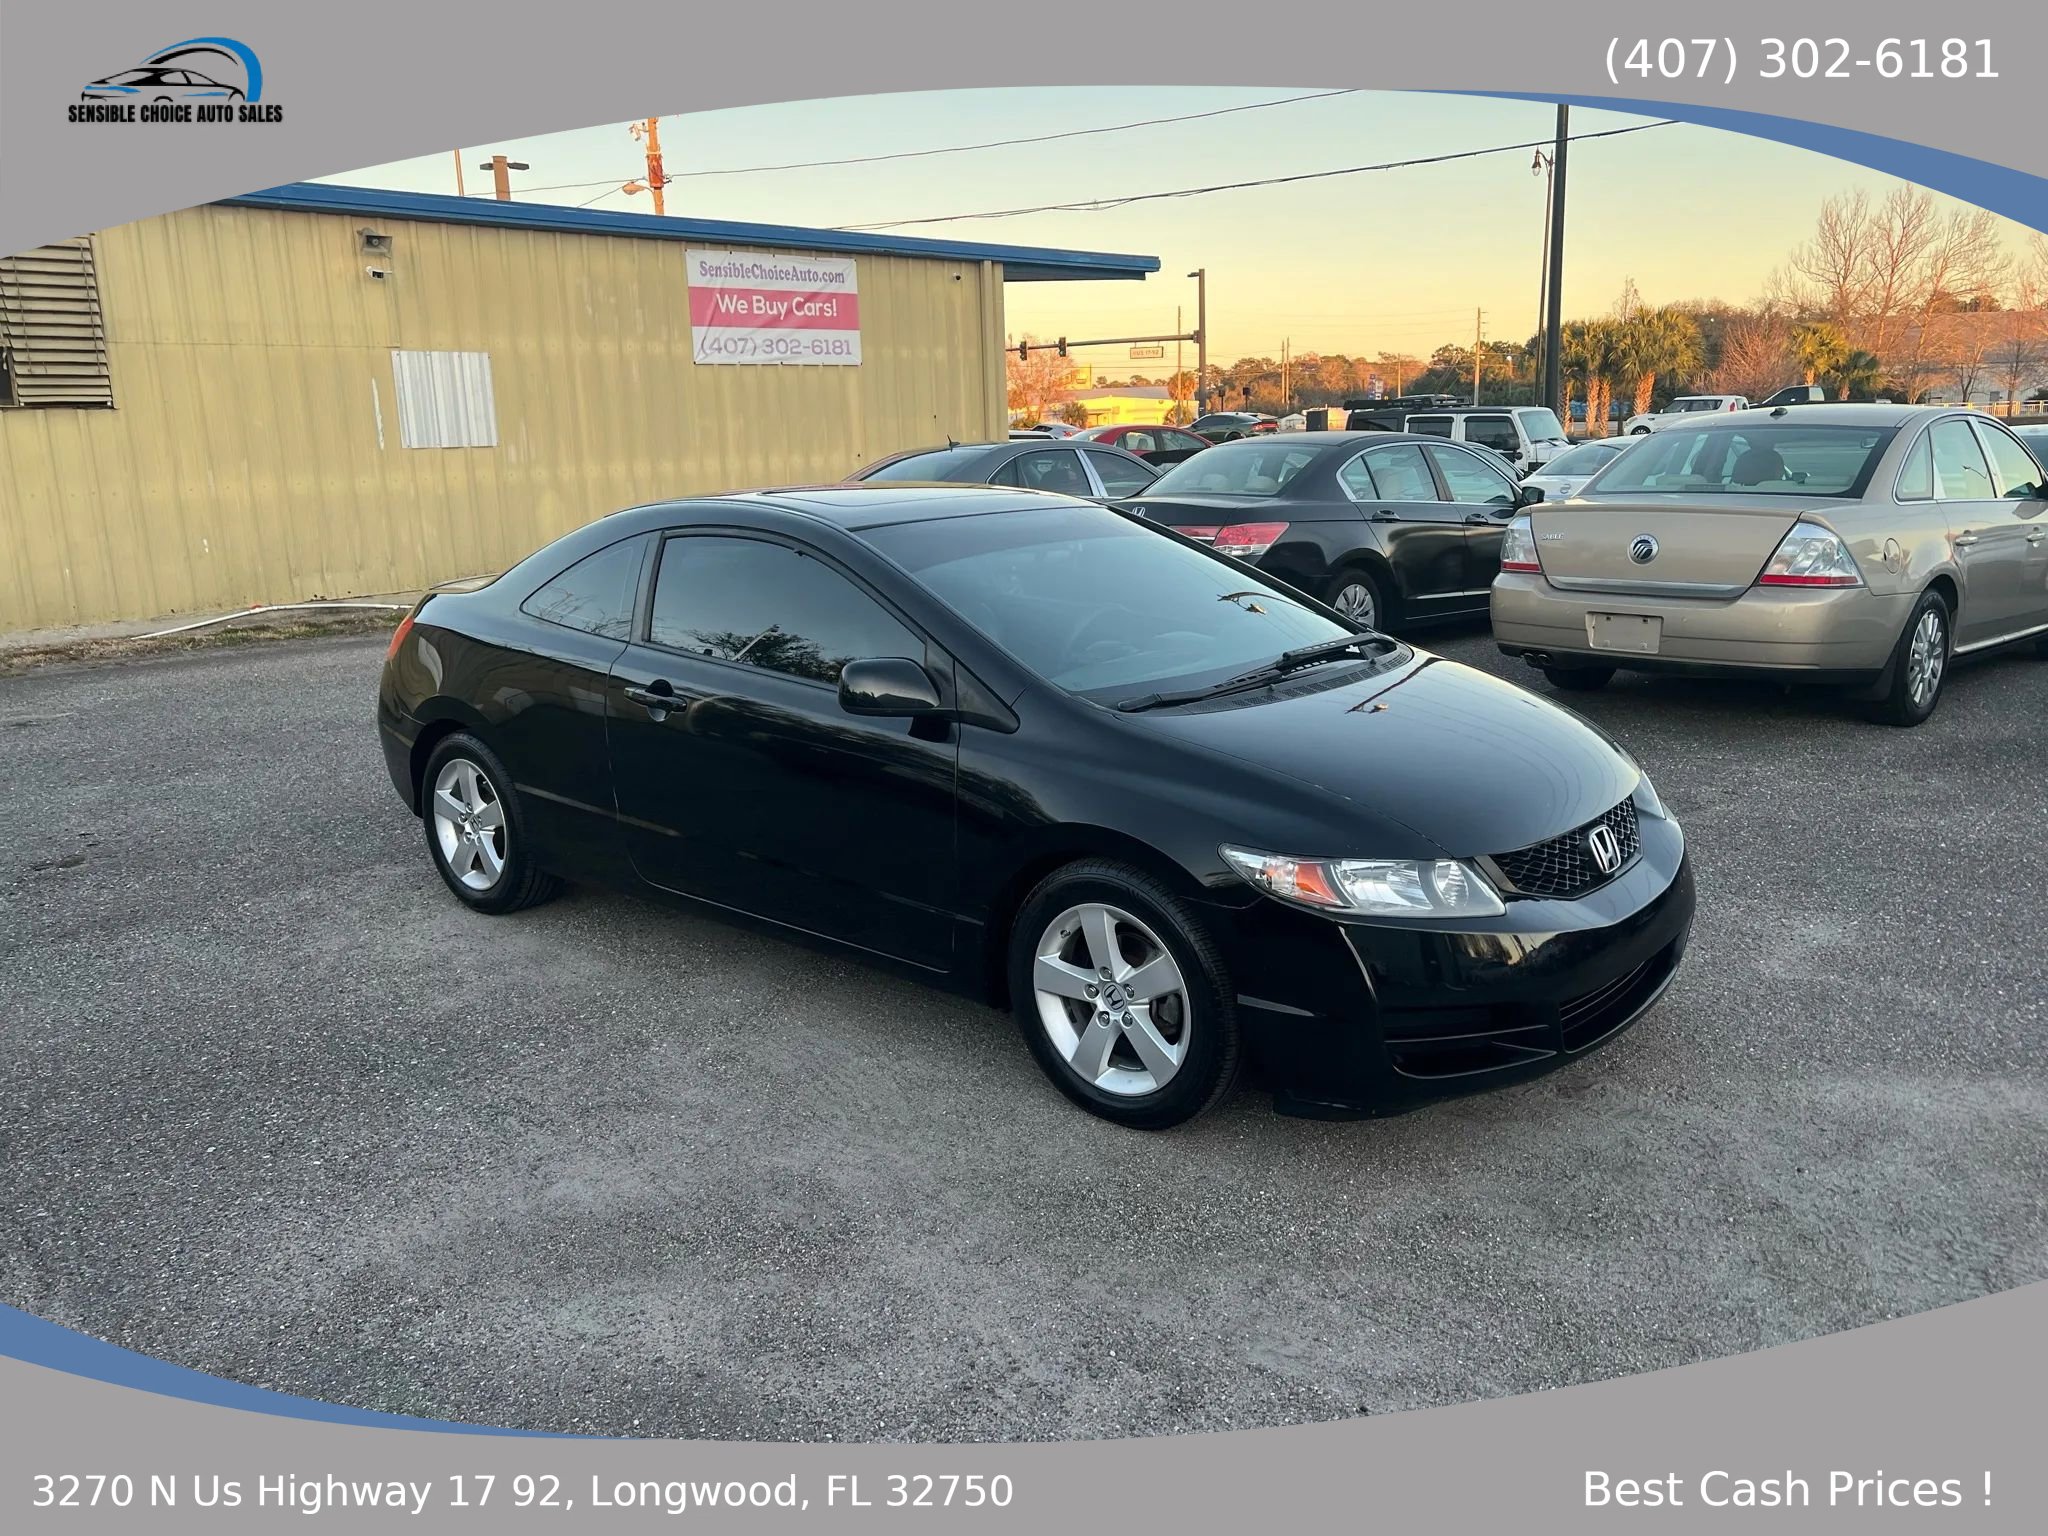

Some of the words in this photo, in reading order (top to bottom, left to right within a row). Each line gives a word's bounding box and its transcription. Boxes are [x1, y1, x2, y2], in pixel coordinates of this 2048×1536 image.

[699, 260, 845, 284] SensibleChoiceAuto.com
[716, 293, 749, 315] We
[752, 295, 788, 321] Buy
[792, 296, 838, 317] Cars!
[700, 335, 757, 357] (407)
[762, 337, 853, 356] 302-6181
